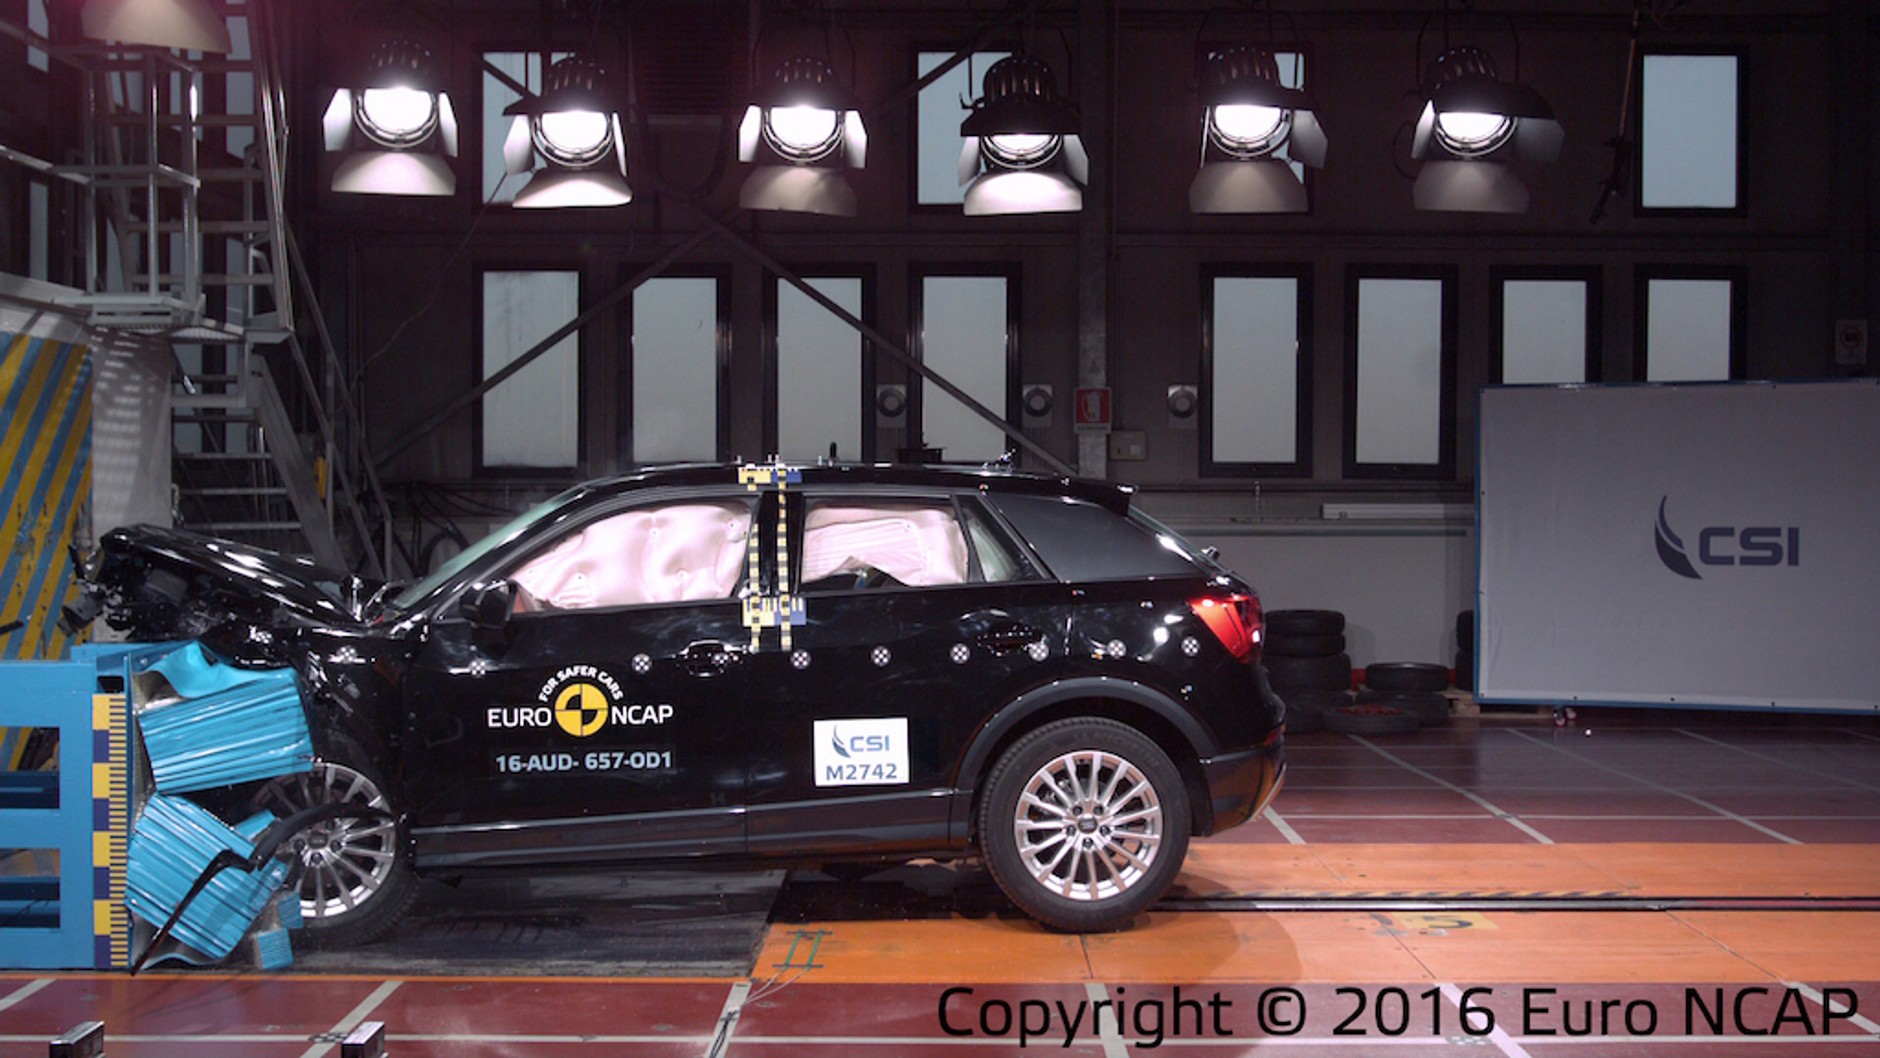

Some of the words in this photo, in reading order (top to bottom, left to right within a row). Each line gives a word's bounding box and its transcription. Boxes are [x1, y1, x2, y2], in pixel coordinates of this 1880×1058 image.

[1699, 527, 1799, 566] CSI
[539, 677, 559, 702] FOR
[556, 665, 598, 681] SAFER
[598, 671, 624, 700] CARS
[487, 707, 552, 728] EURO
[611, 704, 674, 725] NCAP
[849, 734, 890, 753] CSI
[496, 754, 579, 772] 16-AUD-
[826, 762, 898, 781] M2742
